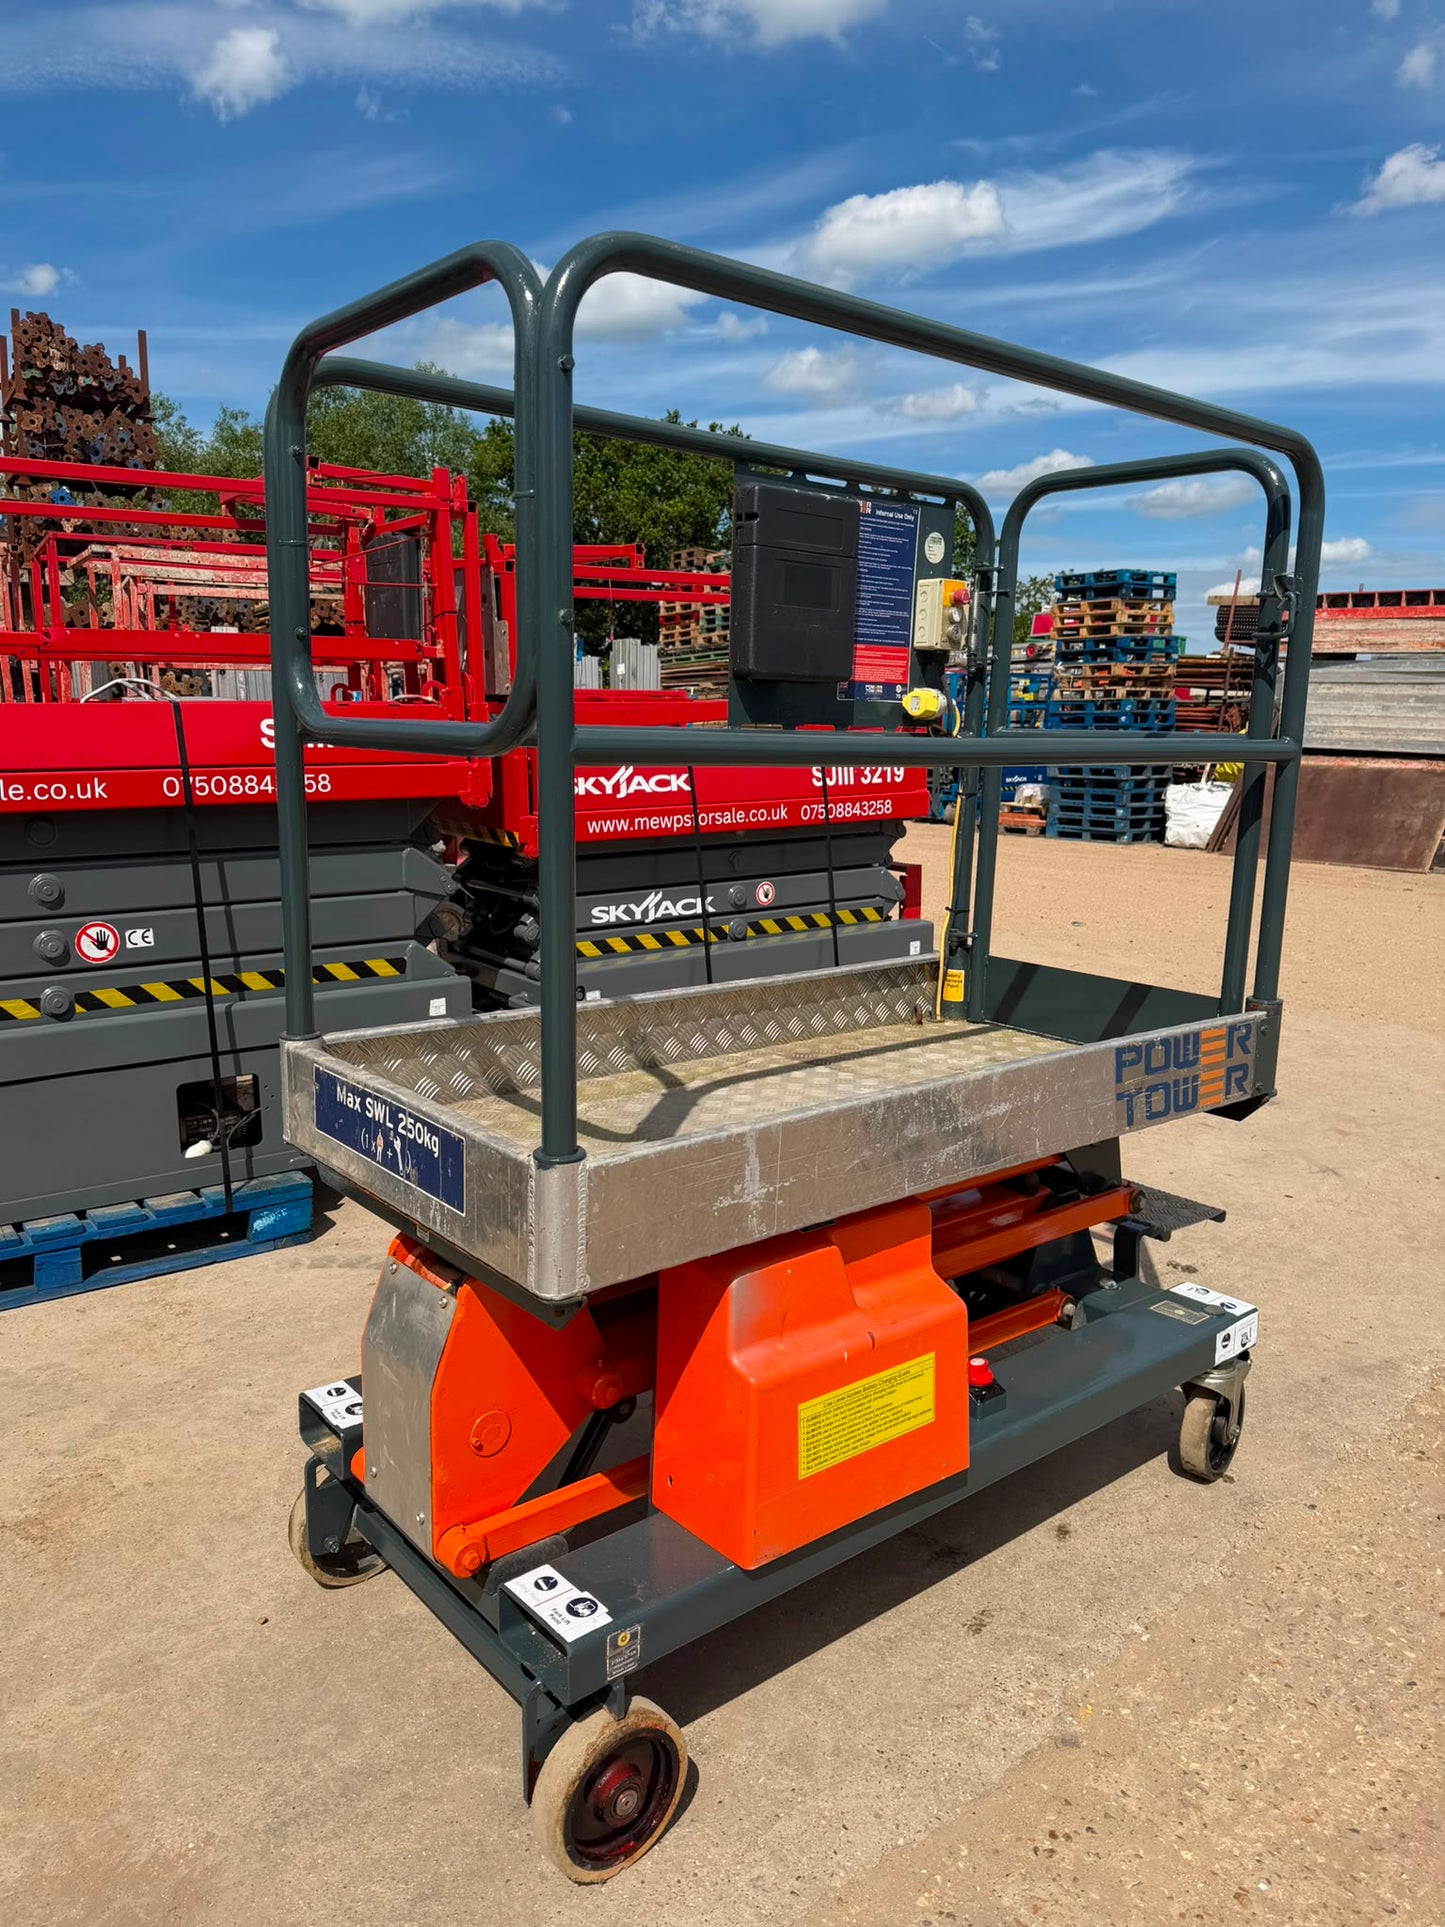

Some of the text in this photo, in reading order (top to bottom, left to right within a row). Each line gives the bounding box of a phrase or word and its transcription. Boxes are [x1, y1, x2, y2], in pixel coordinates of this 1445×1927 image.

[875, 509, 915, 522] Internal Use Only
[162, 773, 332, 797] 05088458
[860, 767, 905, 785] 3219
[587, 799, 893, 834] www.mewpsorsale.co.uk 07508843258
[591, 891, 717, 924] SKYJACK
[128, 928, 153, 946] CE
[1115, 1023, 1251, 1085] POWER
[1116, 1062, 1249, 1127] TOWER
[336, 1083, 439, 1158] Max SWL 250kg
